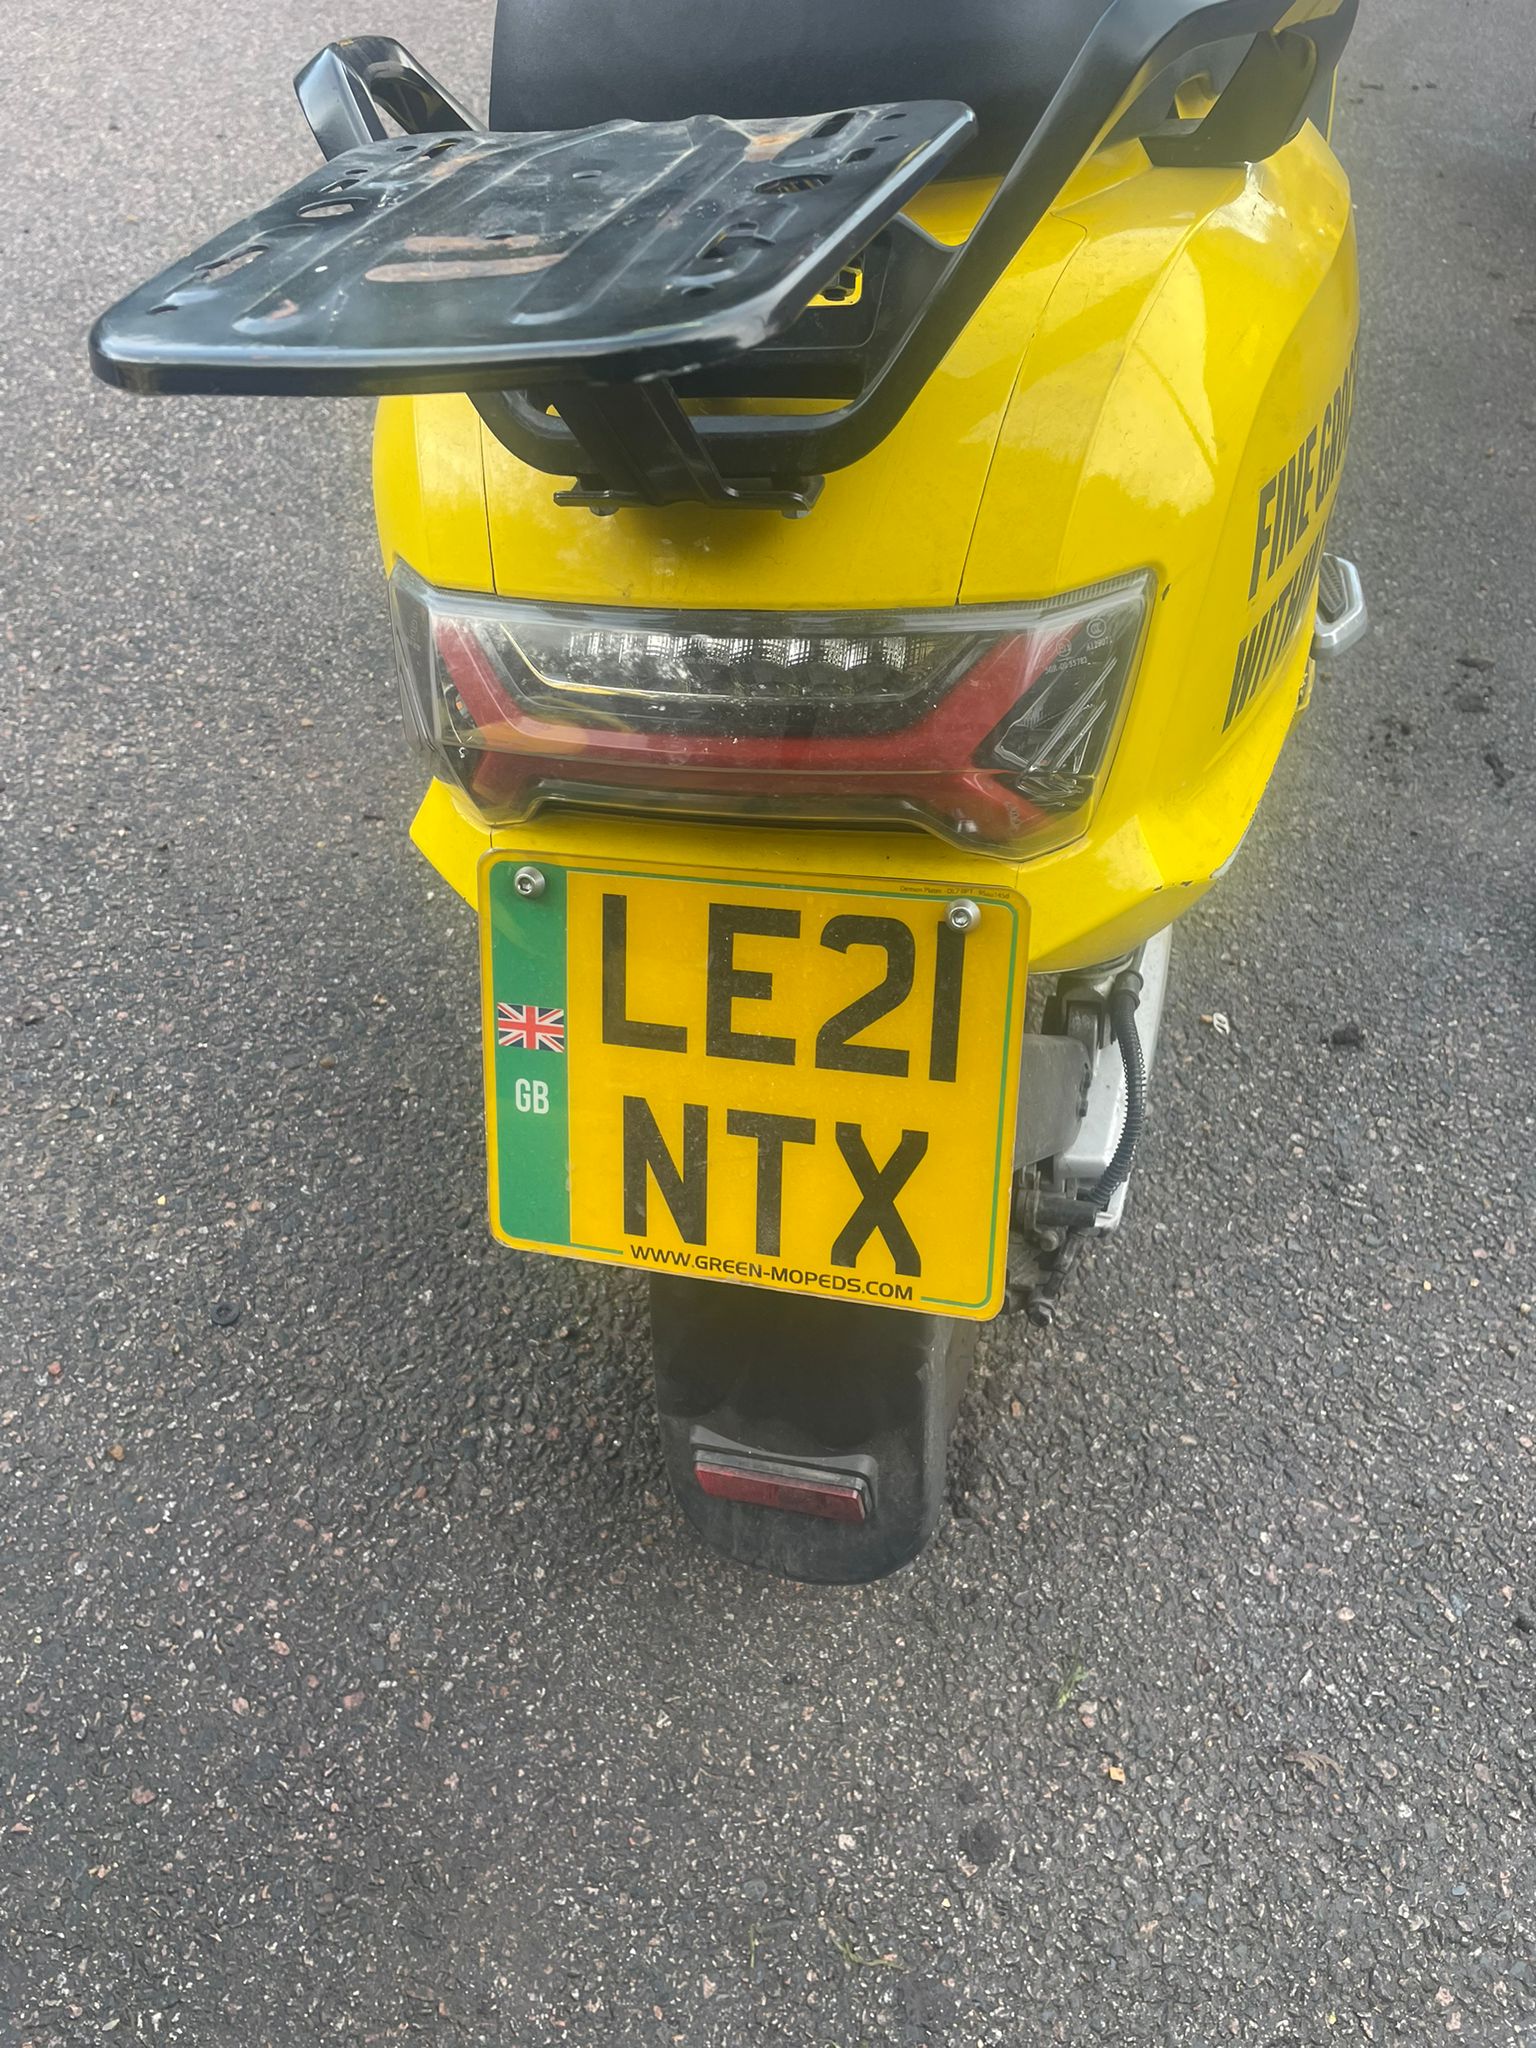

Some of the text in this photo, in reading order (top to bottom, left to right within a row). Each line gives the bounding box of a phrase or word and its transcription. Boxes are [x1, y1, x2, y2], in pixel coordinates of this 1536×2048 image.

[1248, 424, 1317, 602] FINE
[602, 894, 966, 1083] LE21
[515, 1078, 549, 1114] GB
[623, 1096, 929, 1278] NTX
[630, 1244, 913, 1300] WWW.GREEN-MOPEDS.COM
